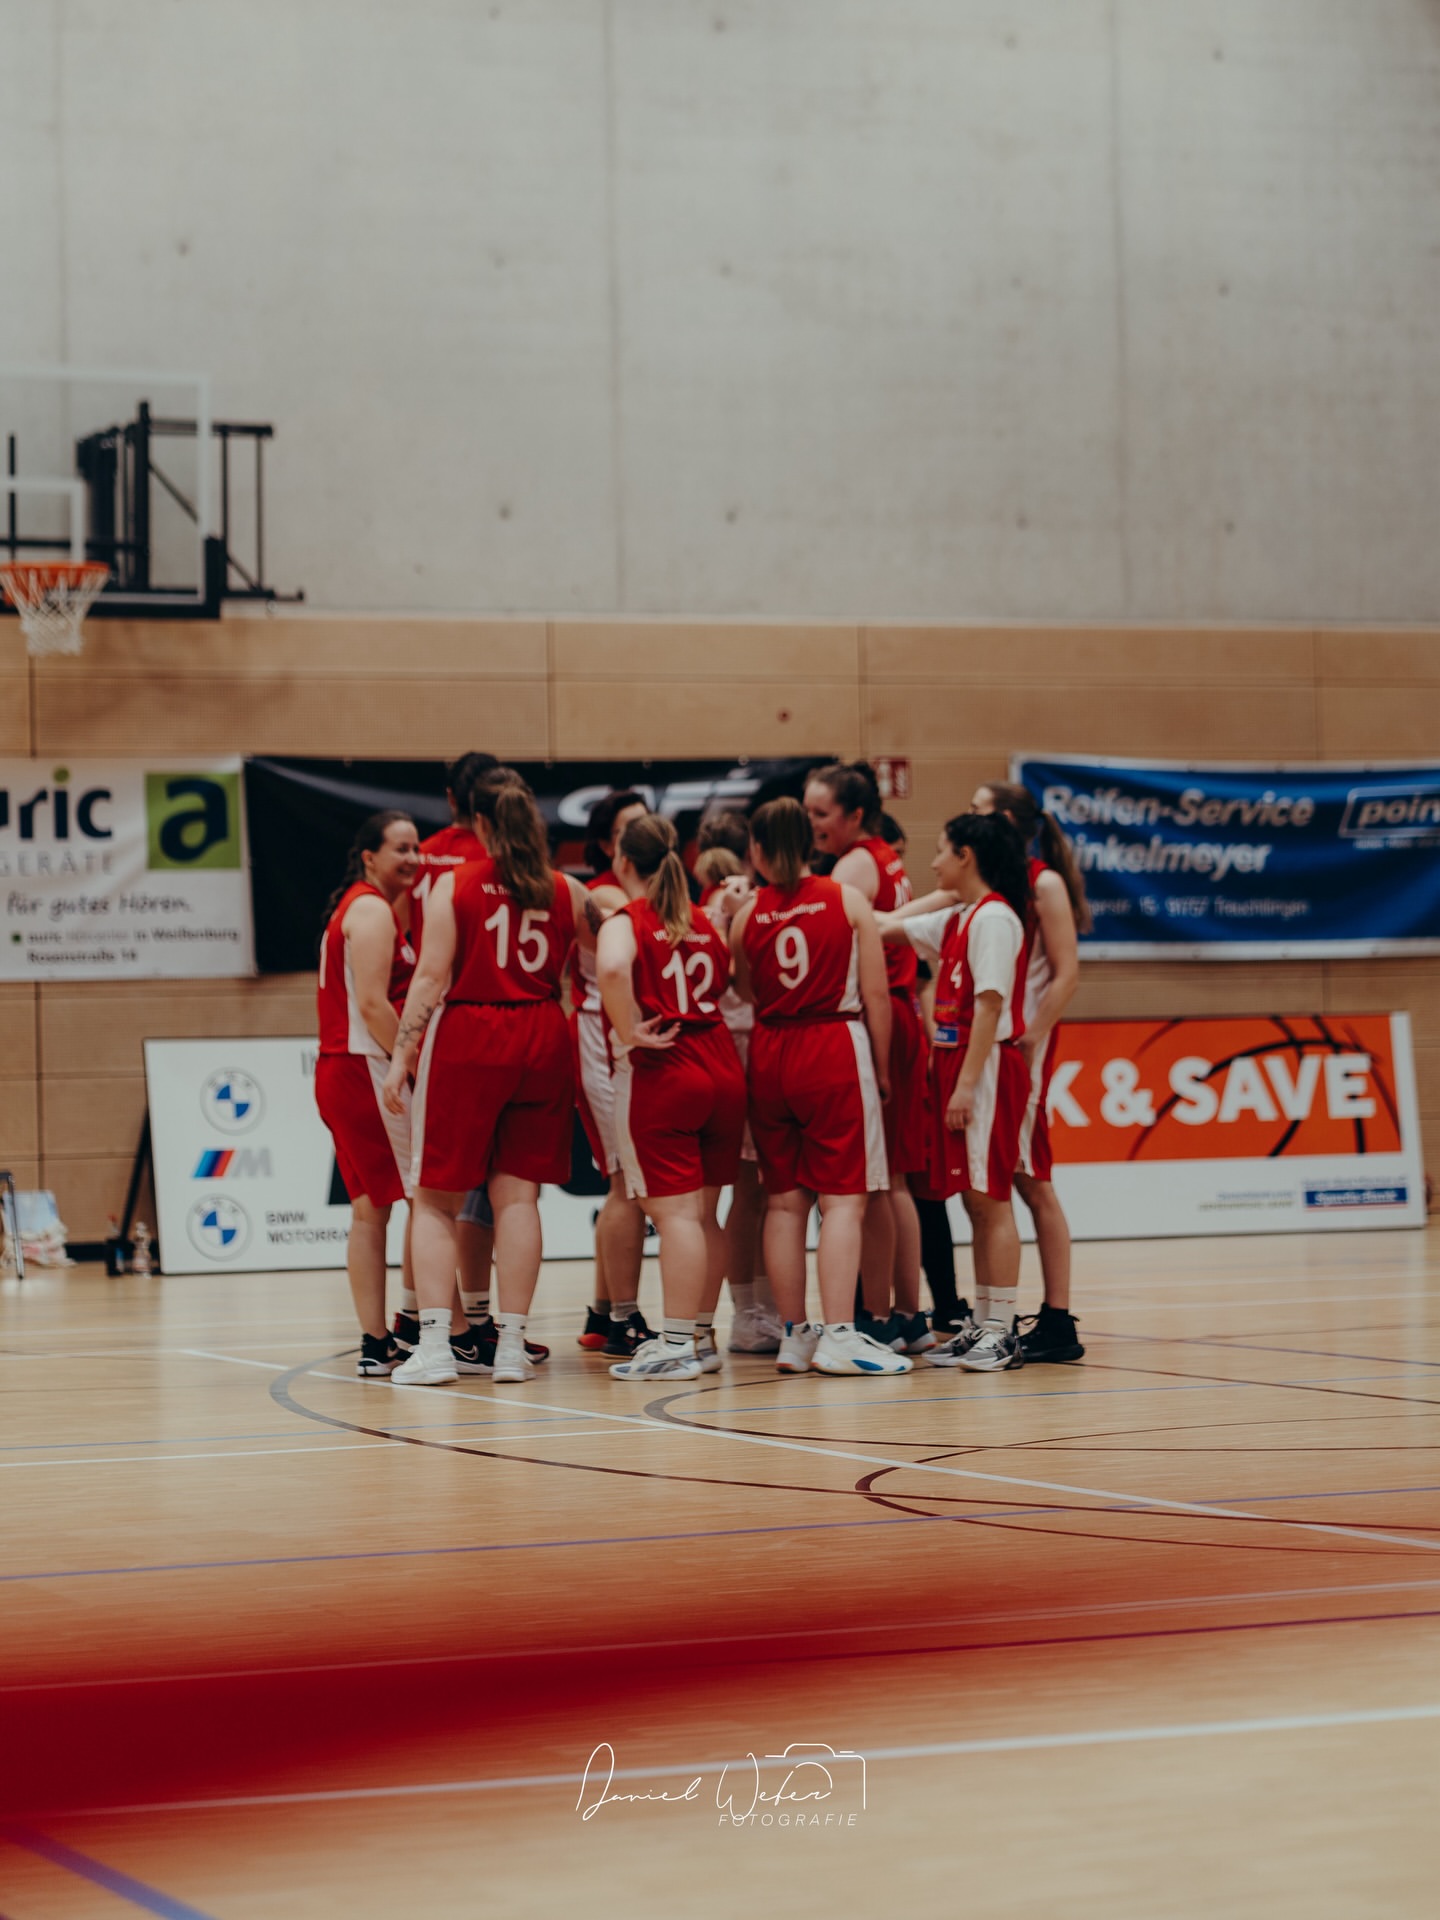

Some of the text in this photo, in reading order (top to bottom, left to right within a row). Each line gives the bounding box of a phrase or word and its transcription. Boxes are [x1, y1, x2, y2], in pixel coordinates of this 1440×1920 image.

[0, 768, 112, 840] ric
[1042, 784, 1315, 828] Reifen-Service
[8, 891, 43, 915] für
[484, 903, 559, 974] 15
[775, 925, 809, 990] 9
[661, 949, 715, 1015] 12
[950, 961, 962, 989] 4
[1100, 1057, 1158, 1128] &
[1167, 1052, 1377, 1126] SAVE
